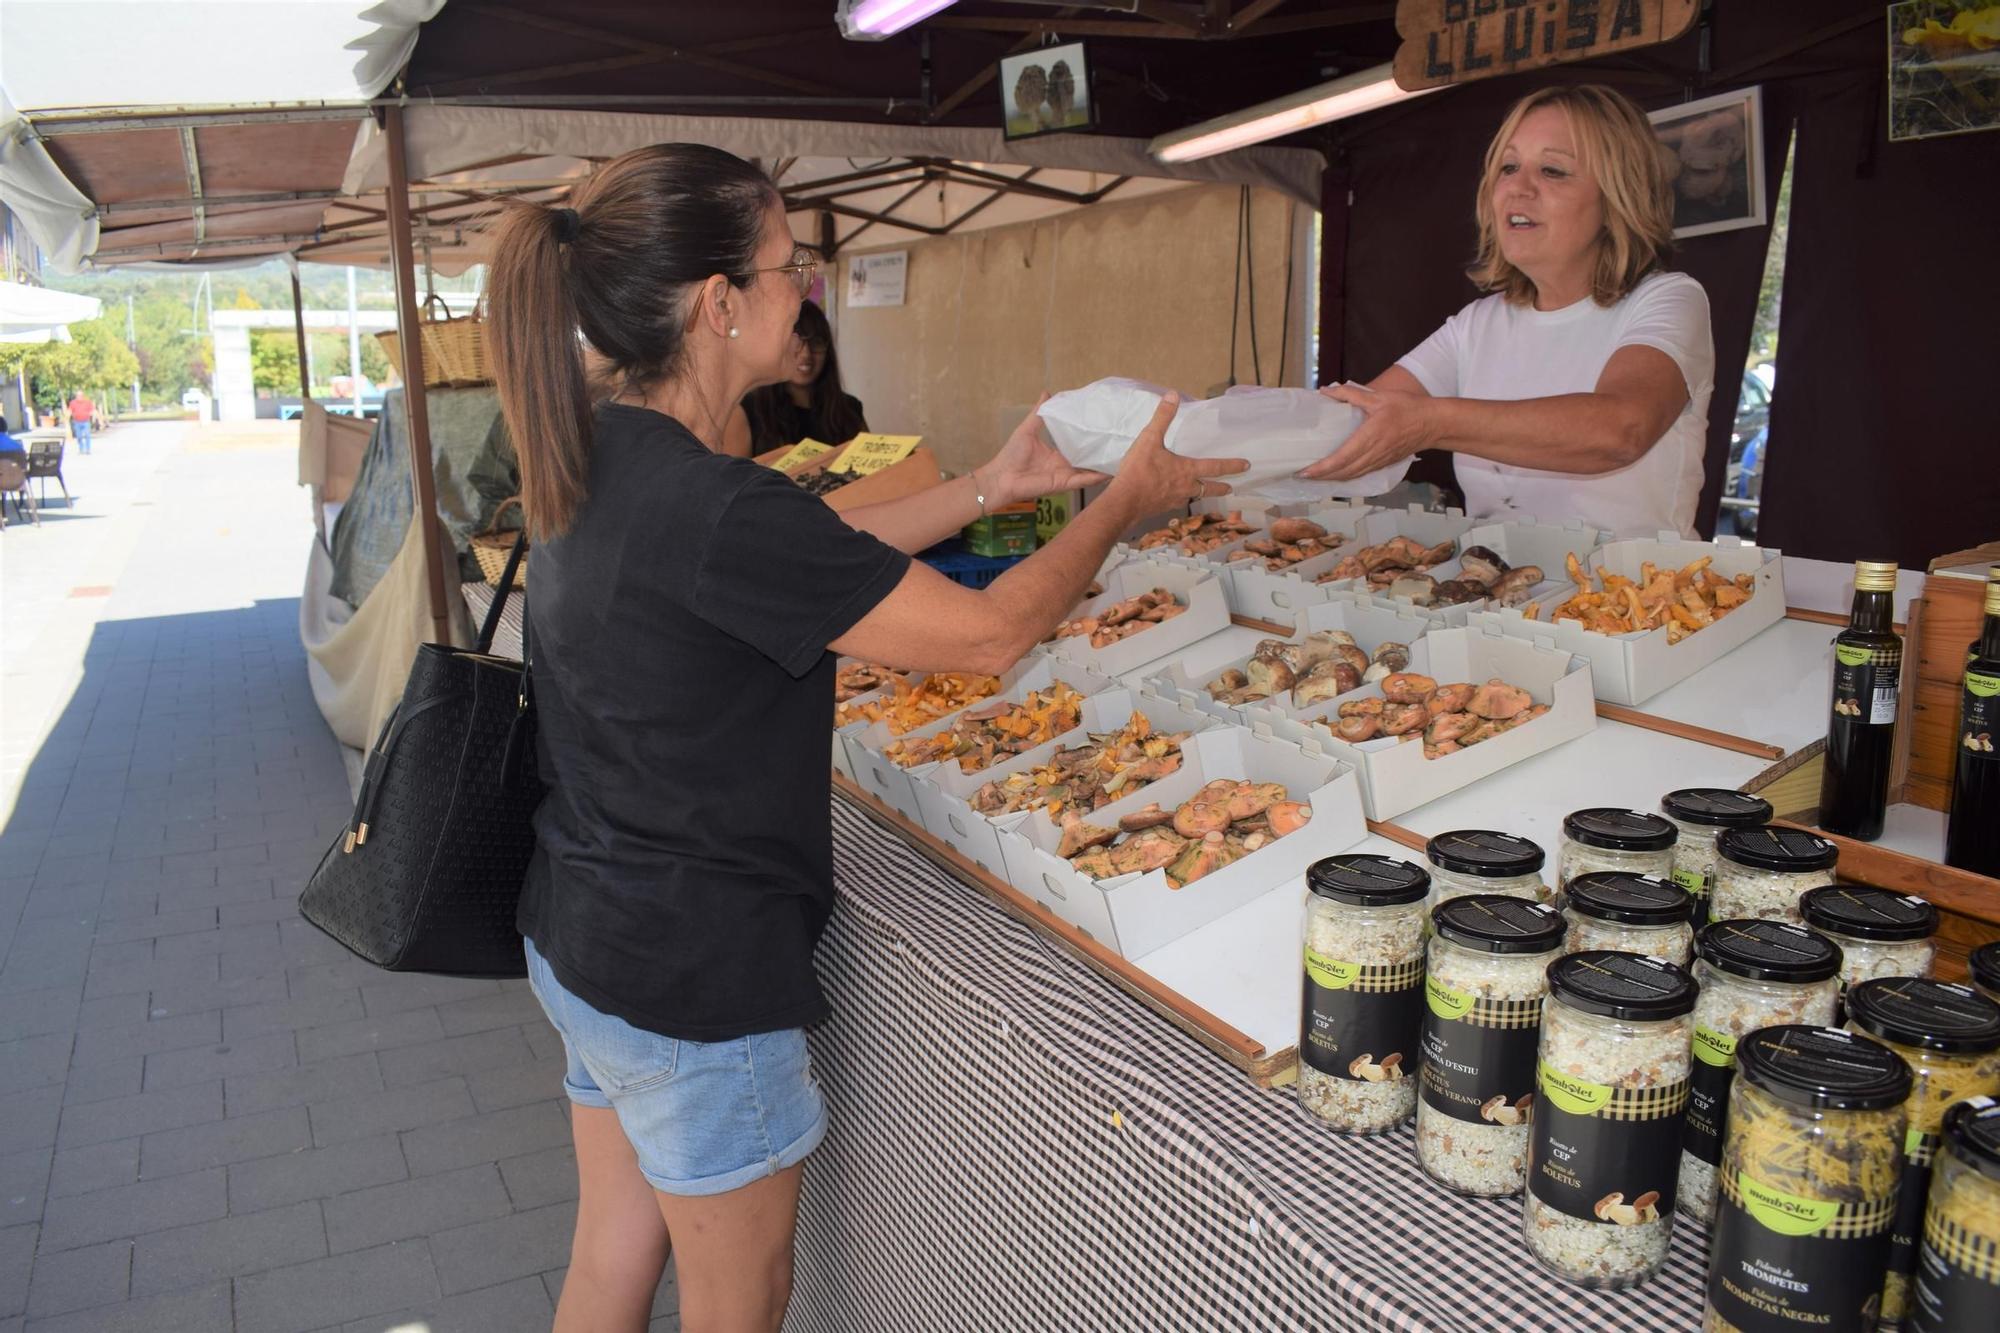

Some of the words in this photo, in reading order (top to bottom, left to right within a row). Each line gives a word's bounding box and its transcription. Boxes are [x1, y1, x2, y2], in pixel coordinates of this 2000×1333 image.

[1315, 1019, 1329, 1029] CEP
[1430, 1041, 1443, 1053] CEP
[1445, 1059, 1479, 1076] D'ESTIU
[1545, 1072, 1593, 1098] monbolet
[1445, 1088, 1481, 1106] VERANO
[1694, 1097, 1709, 1111] CEP
[1553, 1148, 1571, 1161] CEP
[1568, 1146, 1578, 1154] de
[1542, 1164, 1581, 1189] BOLETUS
[1749, 1188, 1816, 1217] monbolet
[1741, 1260, 1809, 1293] TROMPETES
[1782, 1268, 1794, 1278] de
[1721, 1276, 1779, 1315] TROMPETAS
[1780, 1307, 1831, 1324] NEGRAS
[1778, 1296, 1790, 1307] de
